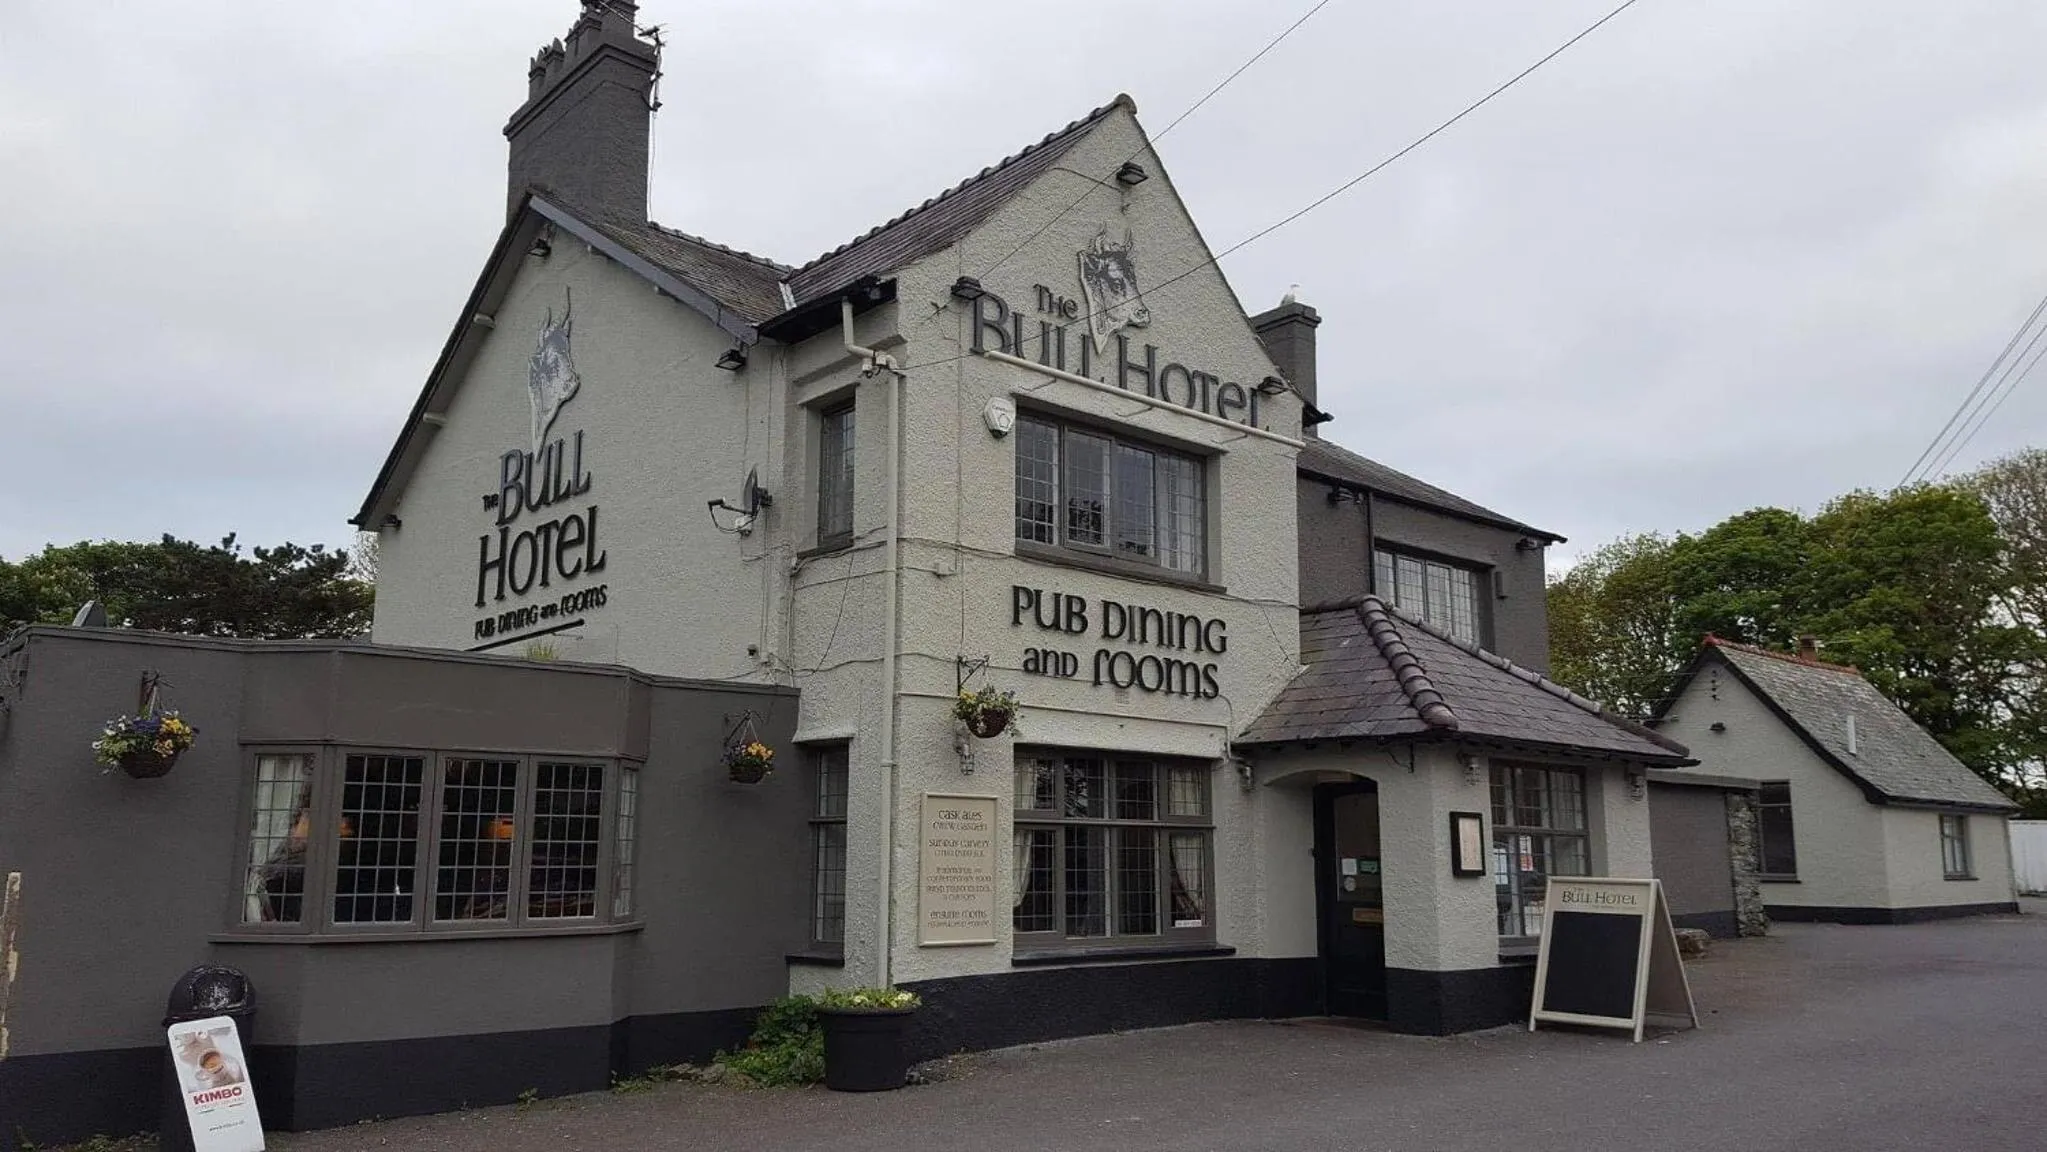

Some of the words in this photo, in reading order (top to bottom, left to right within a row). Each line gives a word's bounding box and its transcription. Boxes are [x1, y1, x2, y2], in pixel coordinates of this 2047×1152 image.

[496, 429, 591, 526] BULL
[474, 505, 606, 608] HOTEL
[475, 617, 495, 641] PUB
[498, 604, 539, 634] DINING
[1011, 585, 1089, 634] PUB
[1101, 599, 1228, 654] DINING
[193, 1086, 242, 1105] KIMBO
